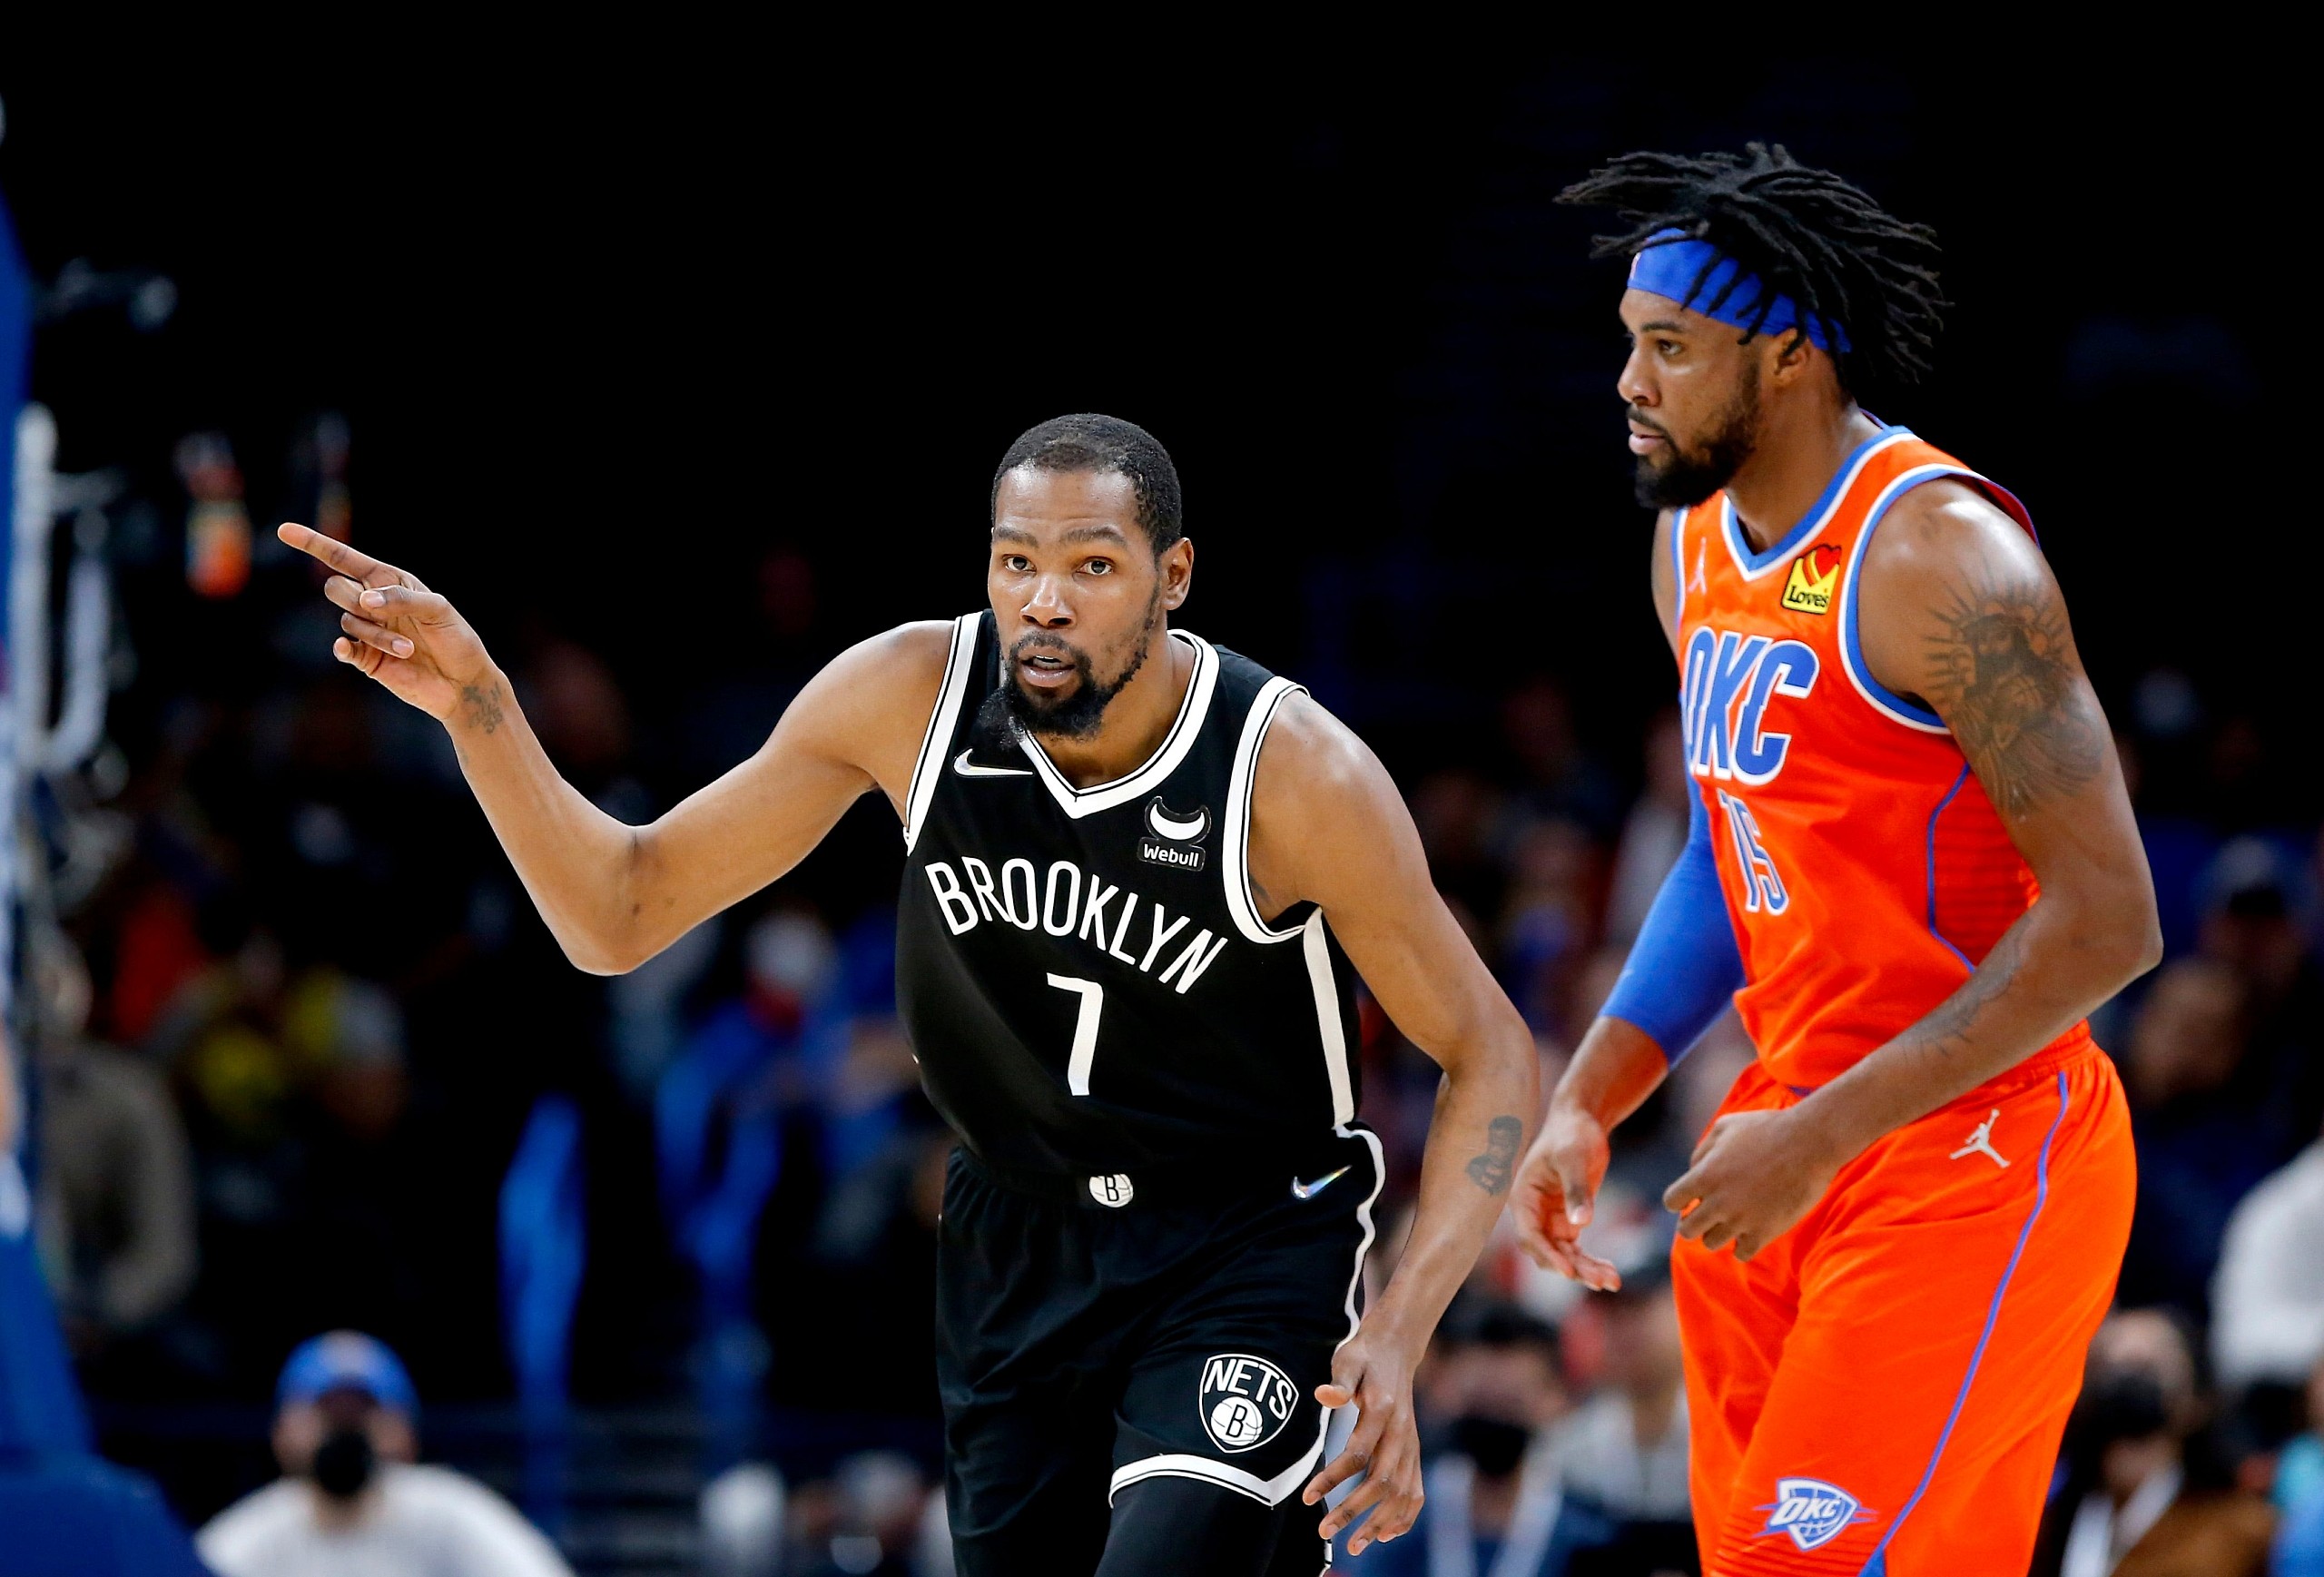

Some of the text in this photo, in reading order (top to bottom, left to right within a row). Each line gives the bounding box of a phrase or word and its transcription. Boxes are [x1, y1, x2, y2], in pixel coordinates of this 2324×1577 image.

[1681, 626, 1819, 786] OKC
[1144, 843, 1199, 868] Webull
[1717, 789, 1789, 915] 15
[924, 856, 1228, 994] BROOKLYN
[1047, 972, 1104, 1096] 7
[1104, 1174, 1120, 1202] B
[1204, 1358, 1293, 1421] NETS
[1226, 1404, 1248, 1438] B
[1769, 1496, 1841, 1527] OKC
